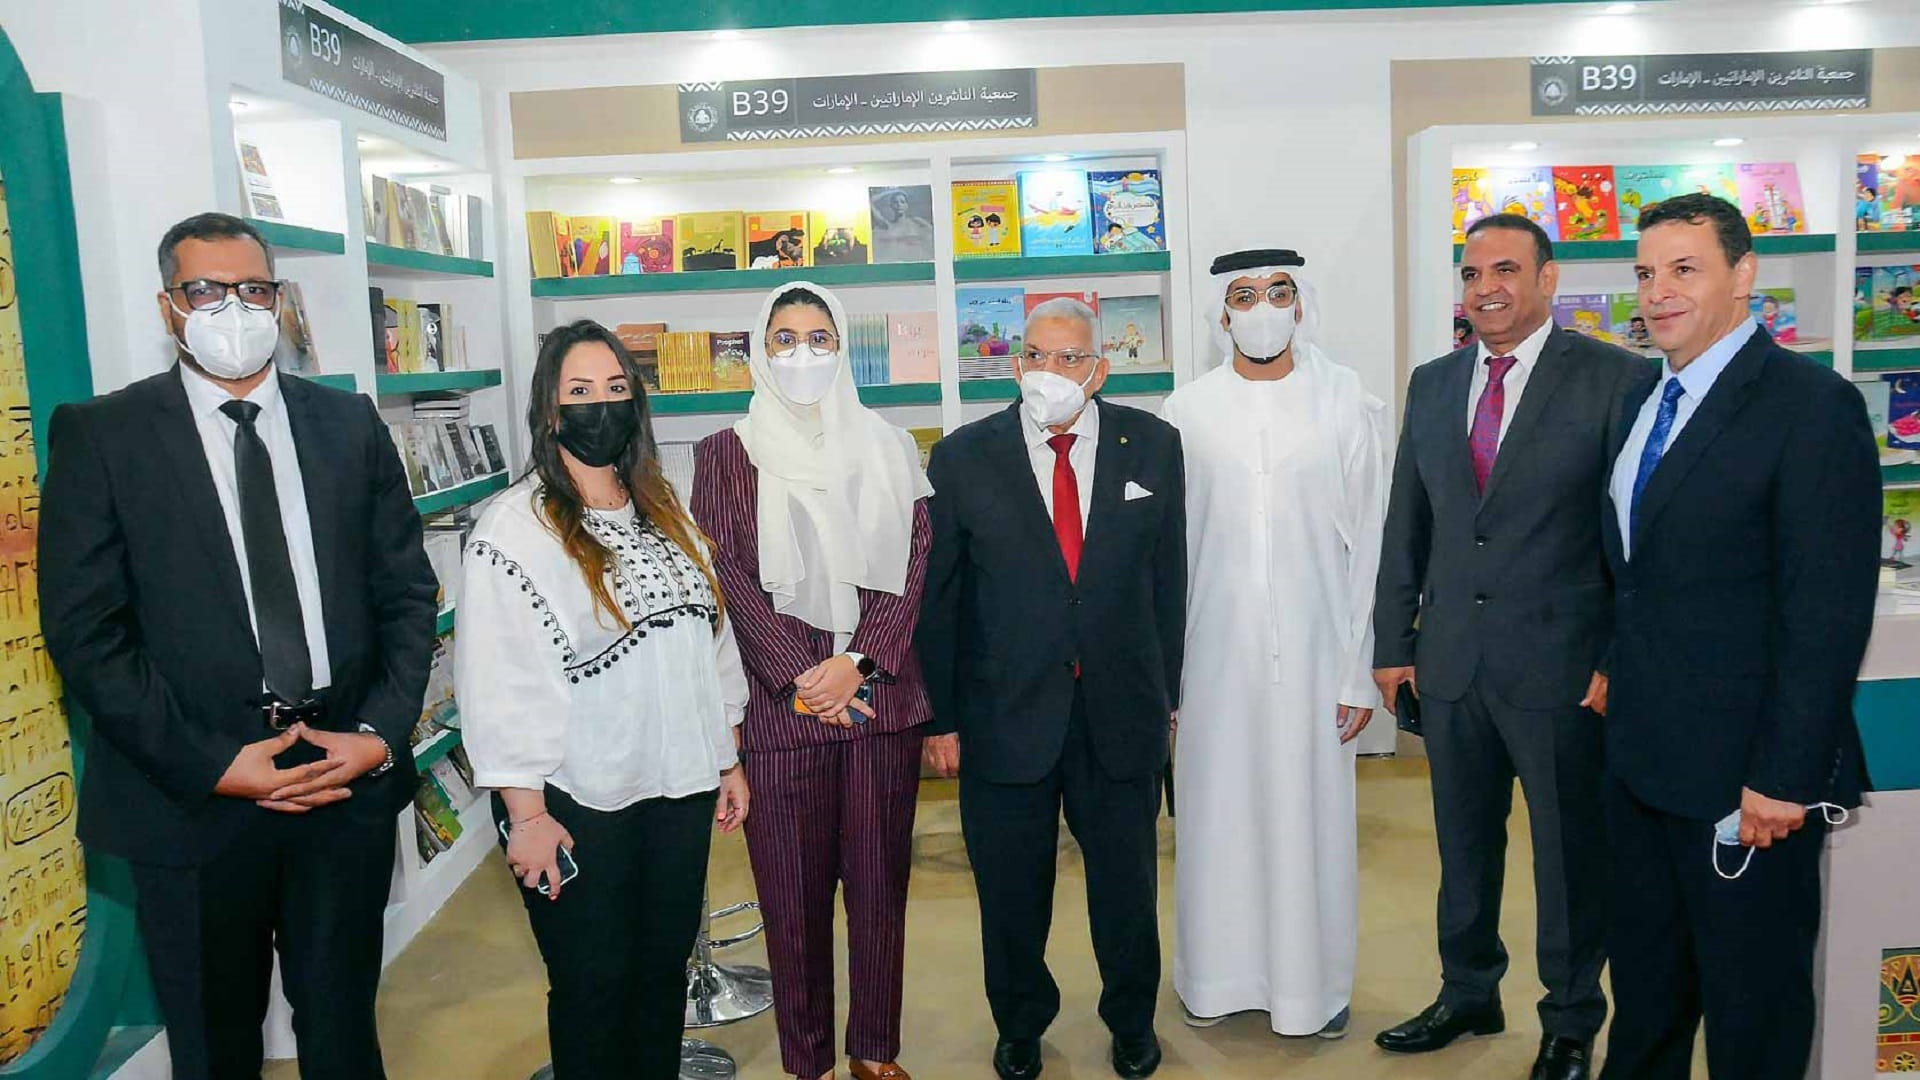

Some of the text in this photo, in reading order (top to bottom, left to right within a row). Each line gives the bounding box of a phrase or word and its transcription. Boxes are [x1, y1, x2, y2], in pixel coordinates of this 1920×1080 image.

[309, 22, 342, 66] B39
[1582, 64, 1637, 91] B39
[1816, 66, 1856, 83] جمعية
[732, 89, 789, 116] B39
[812, 92, 858, 112] الإمارات
[871, 90, 924, 109] الإماراتيين
[929, 87, 975, 105] الناشرين
[980, 87, 1018, 103] جمعية
